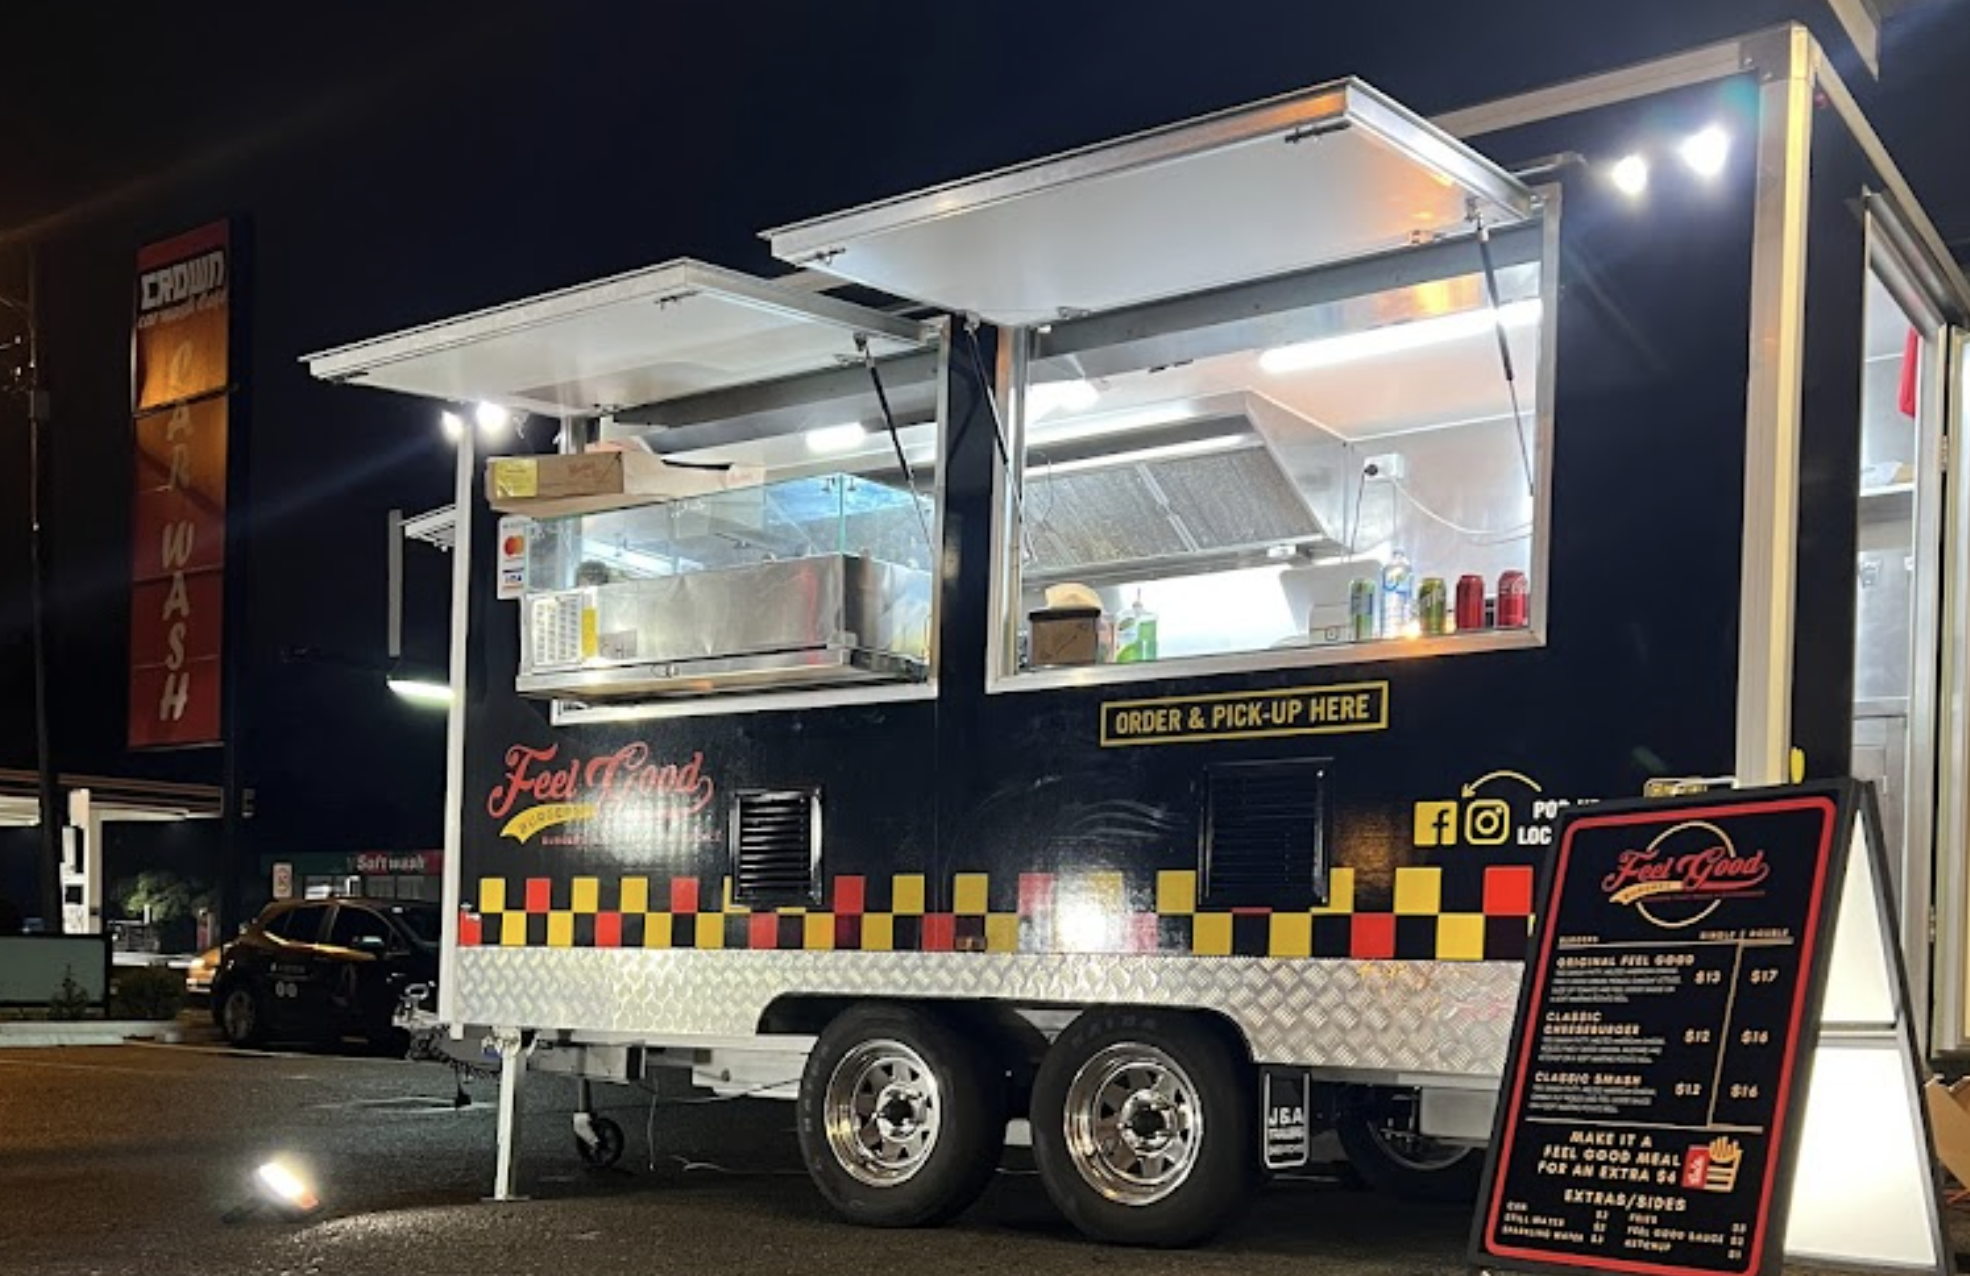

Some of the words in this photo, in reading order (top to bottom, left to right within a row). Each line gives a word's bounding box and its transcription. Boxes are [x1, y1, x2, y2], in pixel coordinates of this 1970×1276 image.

[160, 519, 195, 721] WASH
[1115, 708, 1181, 735] ORDER
[1189, 706, 1205, 730] &
[1212, 699, 1302, 729] PICK-UP
[1310, 694, 1370, 722] HERE
[486, 743, 580, 818] Feel
[585, 741, 714, 816] Good
[1601, 849, 1675, 892] Feel
[1676, 846, 1771, 891] Good
[1557, 957, 1616, 969] ORIGINAL
[1620, 955, 1649, 967] FEEL
[1653, 954, 1695, 967] GOOD
[1545, 1011, 1602, 1023] CLASSIC
[1543, 1024, 1641, 1037] CHEESEBURGER
[1534, 1071, 1590, 1085] CLASSIC
[1593, 1073, 1642, 1087] SMASH
[1569, 1130, 1616, 1145] MAKE
[1619, 1132, 1636, 1147] IT
[1640, 1135, 1653, 1148] A
[1543, 1144, 1578, 1160] FEEL
[1582, 1147, 1631, 1164] GOOD
[1635, 1151, 1681, 1167] MEAL
[1537, 1160, 1568, 1176] FOR
[1572, 1162, 1595, 1177] AN
[1599, 1164, 1649, 1183] EXTRA
[1563, 1188, 1687, 1212] EXTRAS/SIDES
